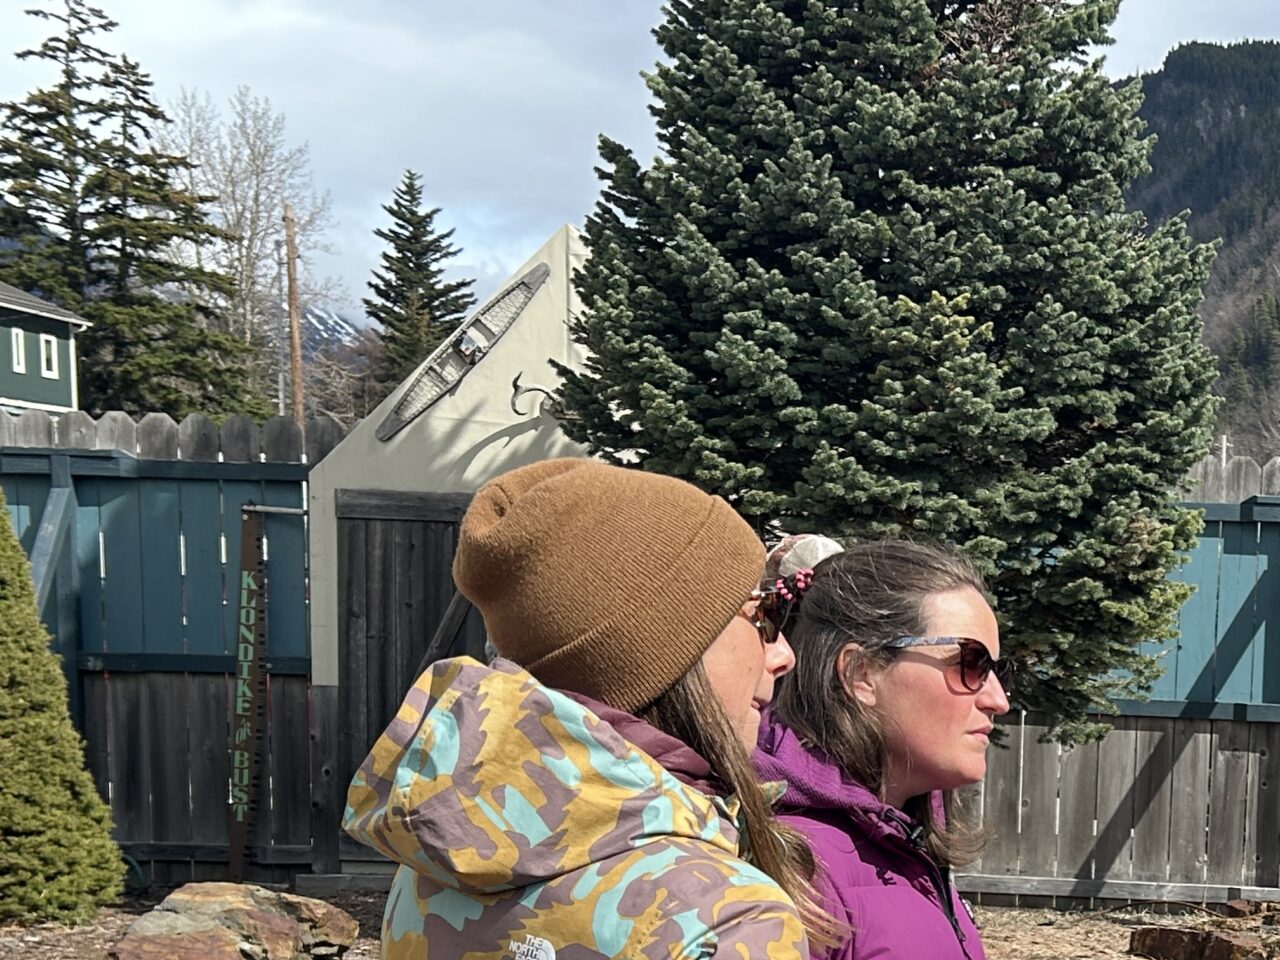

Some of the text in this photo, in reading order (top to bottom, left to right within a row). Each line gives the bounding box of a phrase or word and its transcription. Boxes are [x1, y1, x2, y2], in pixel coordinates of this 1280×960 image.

[236, 570, 258, 716] KLONDIKE
[233, 750, 250, 822] BUST
[509, 940, 540, 959] NORTH
[526, 934, 544, 947] THE
